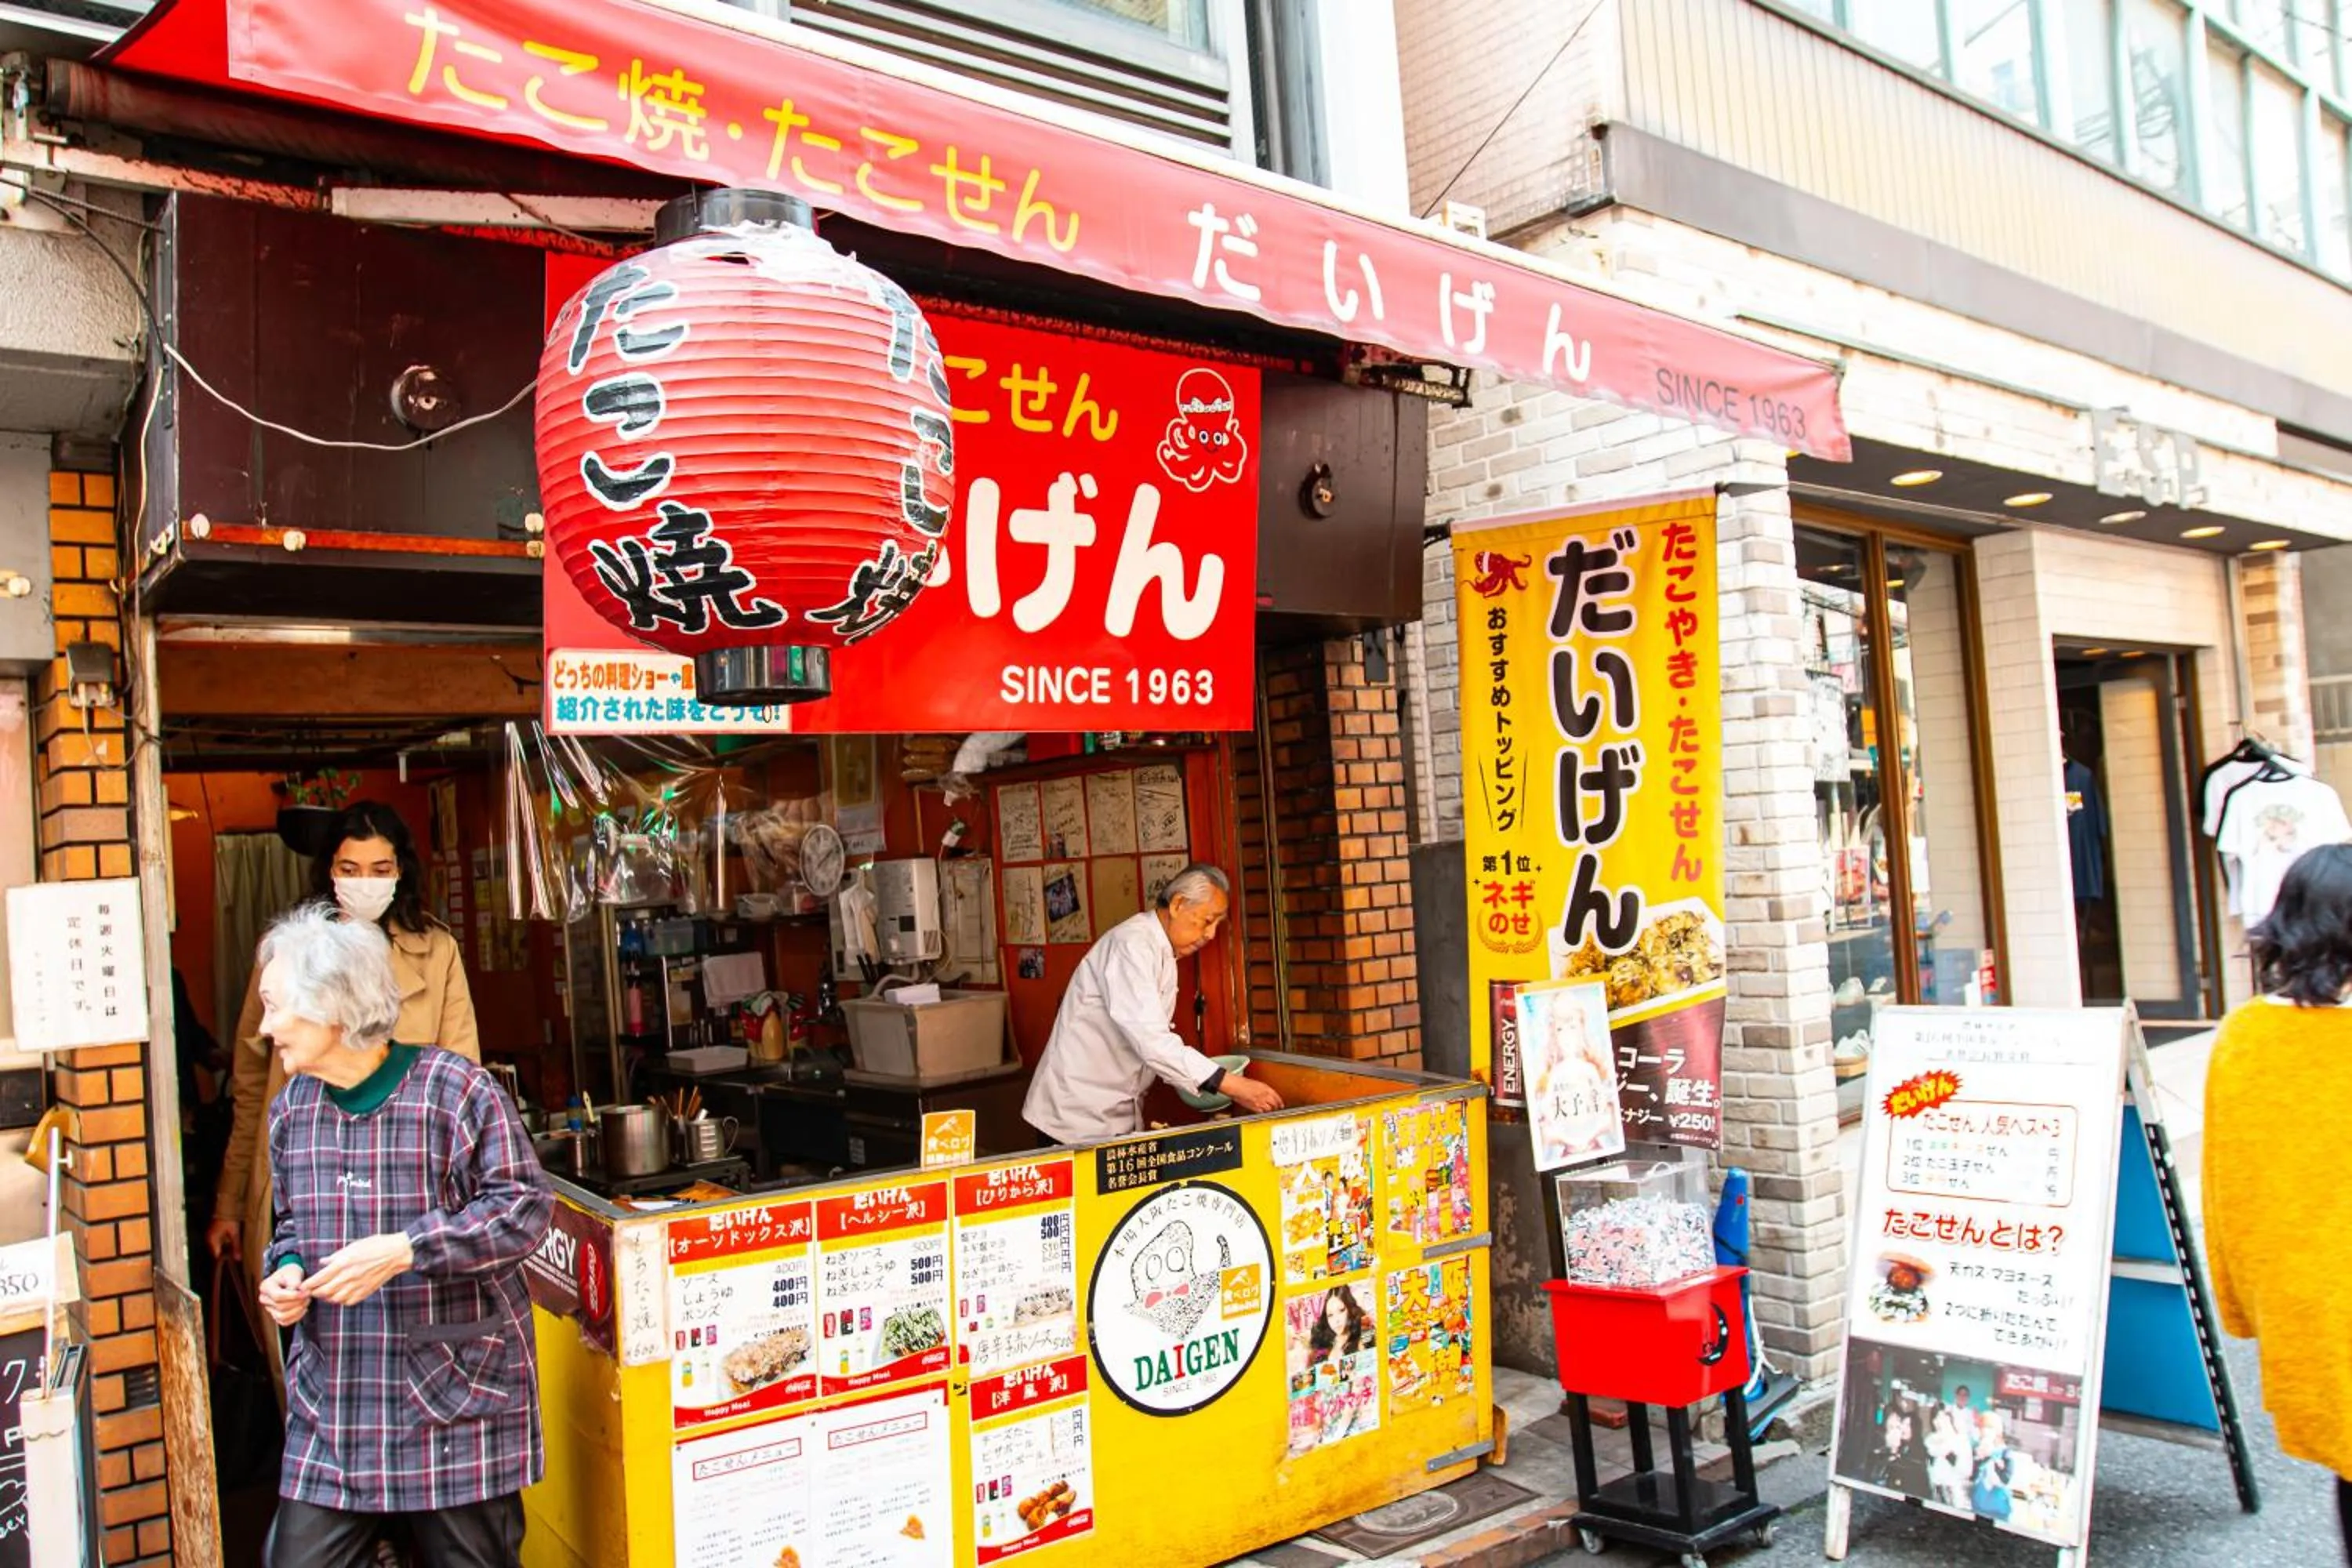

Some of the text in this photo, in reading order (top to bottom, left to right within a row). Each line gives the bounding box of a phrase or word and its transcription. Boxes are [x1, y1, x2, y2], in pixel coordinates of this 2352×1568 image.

[405, 6, 1080, 253] たこ焼・たこせん
[1188, 201, 1592, 382] だいげん
[1656, 368, 1807, 441] SINCE 1963
[568, 263, 787, 633] たこ焼
[924, 471, 1225, 641] げん
[1000, 666, 1214, 705] SINCE 1963
[1486, 606, 1517, 833] おすすめトッピング
[1661, 521, 1703, 883] たこやき・たこせん
[1547, 527, 1642, 952] だいげん
[1482, 879, 1535, 909] ネギ
[1489, 910, 1530, 937] のせ
[1502, 1019, 1515, 1094] ENERGY
[1618, 1047, 1686, 1075] コーラ
[772, 1276, 808, 1293] 400円
[910, 1254, 943, 1271] 500円
[910, 1269, 943, 1285] 500円
[772, 1291, 808, 1308] 400円
[1134, 1328, 1240, 1392] DAIGEN
